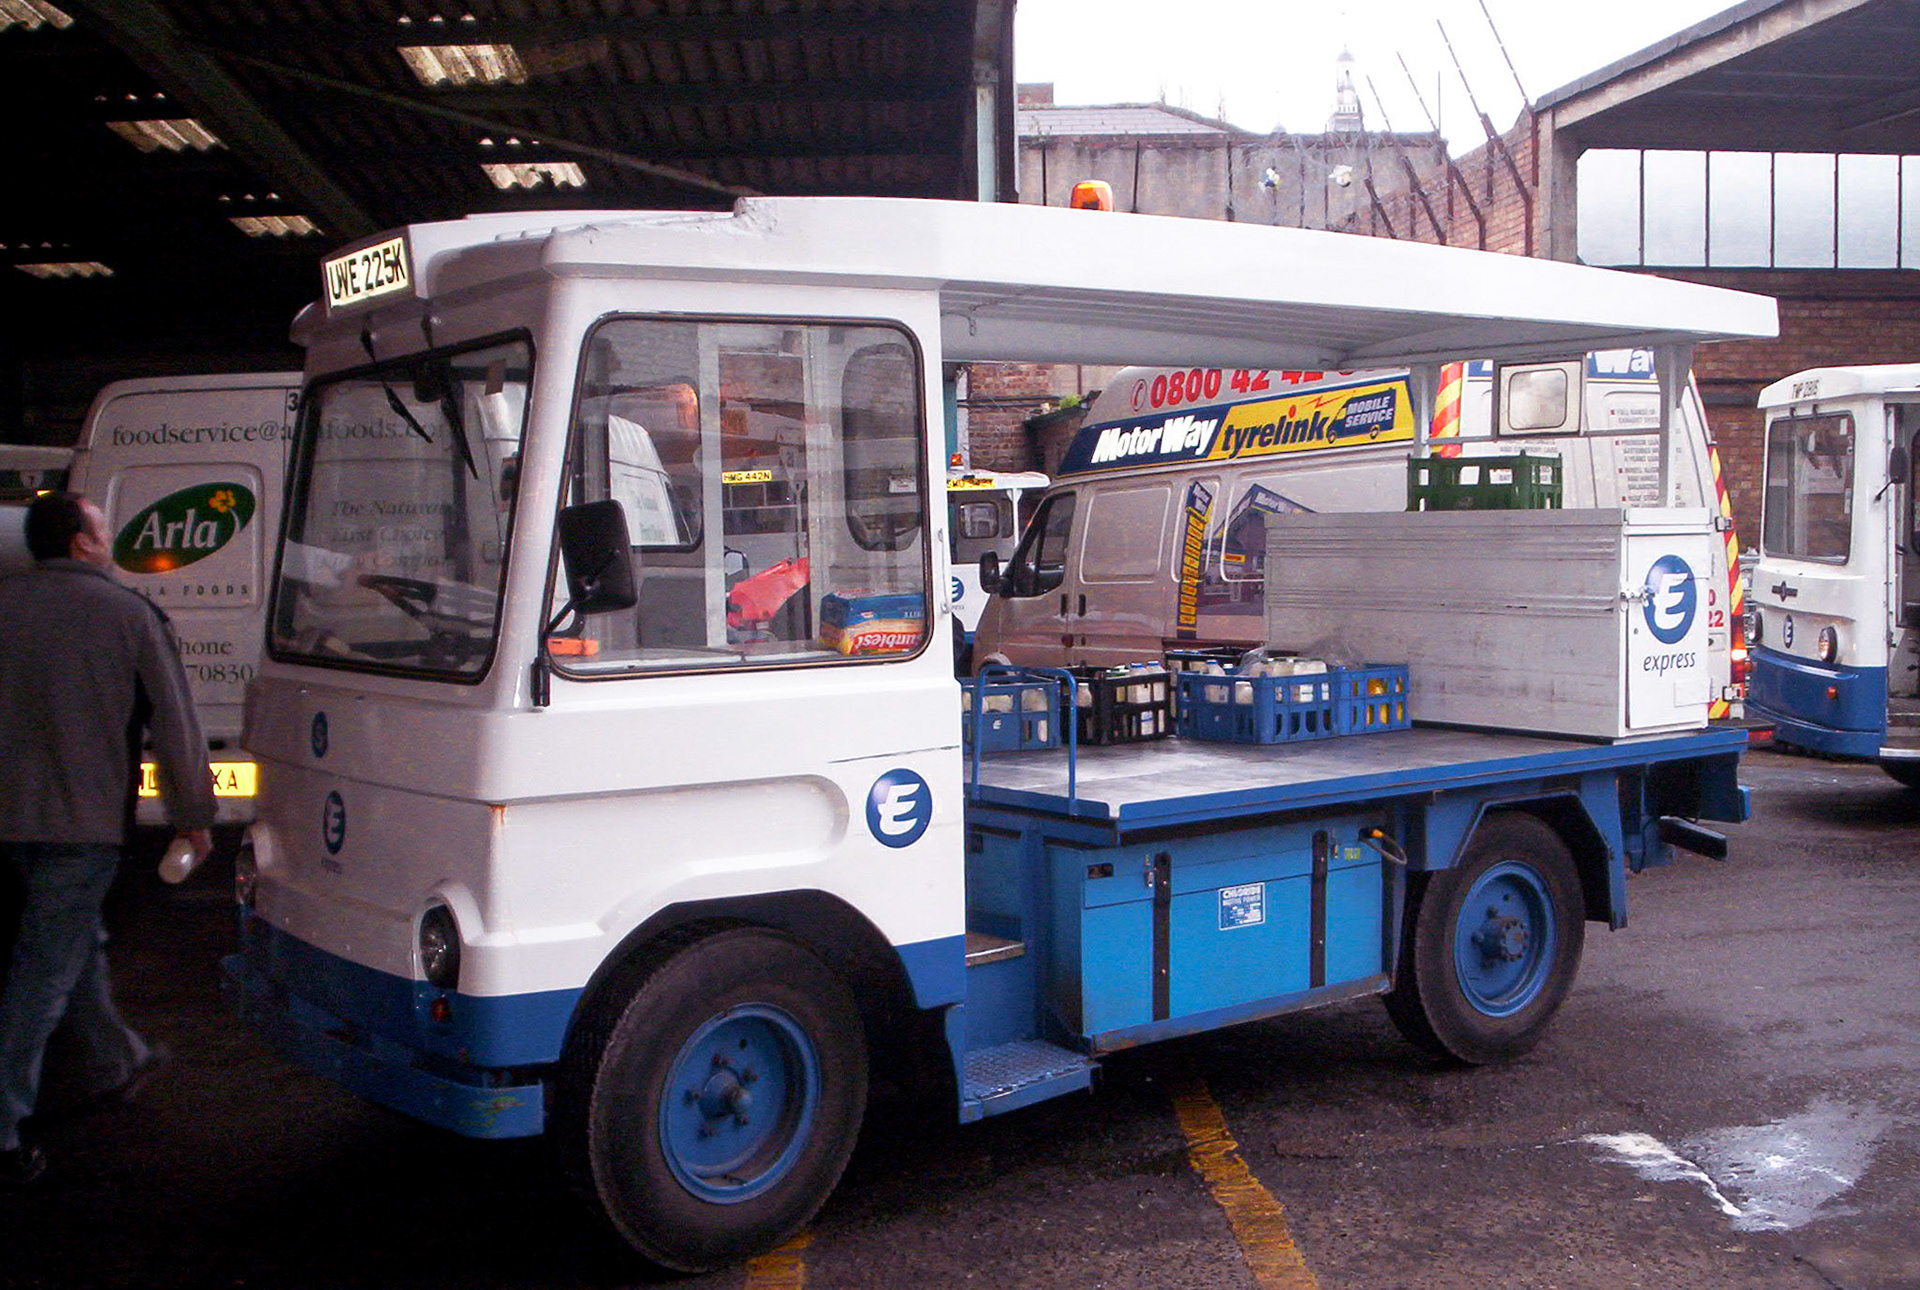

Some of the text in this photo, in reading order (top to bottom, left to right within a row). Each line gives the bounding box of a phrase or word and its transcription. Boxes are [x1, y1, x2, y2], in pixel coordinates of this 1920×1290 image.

[362, 243, 406, 291] 225K
[1150, 369, 1222, 409] 0800
[1346, 396, 1391, 415] MOBILE
[1345, 408, 1394, 428] SERVICE
[1091, 405, 1329, 463] MotorWay tyrelink
[133, 508, 218, 549] Arla
[183, 584, 249, 597] FOODS
[178, 636, 233, 656] hone
[855, 633, 921, 650] unblest
[1643, 652, 1696, 677] express
